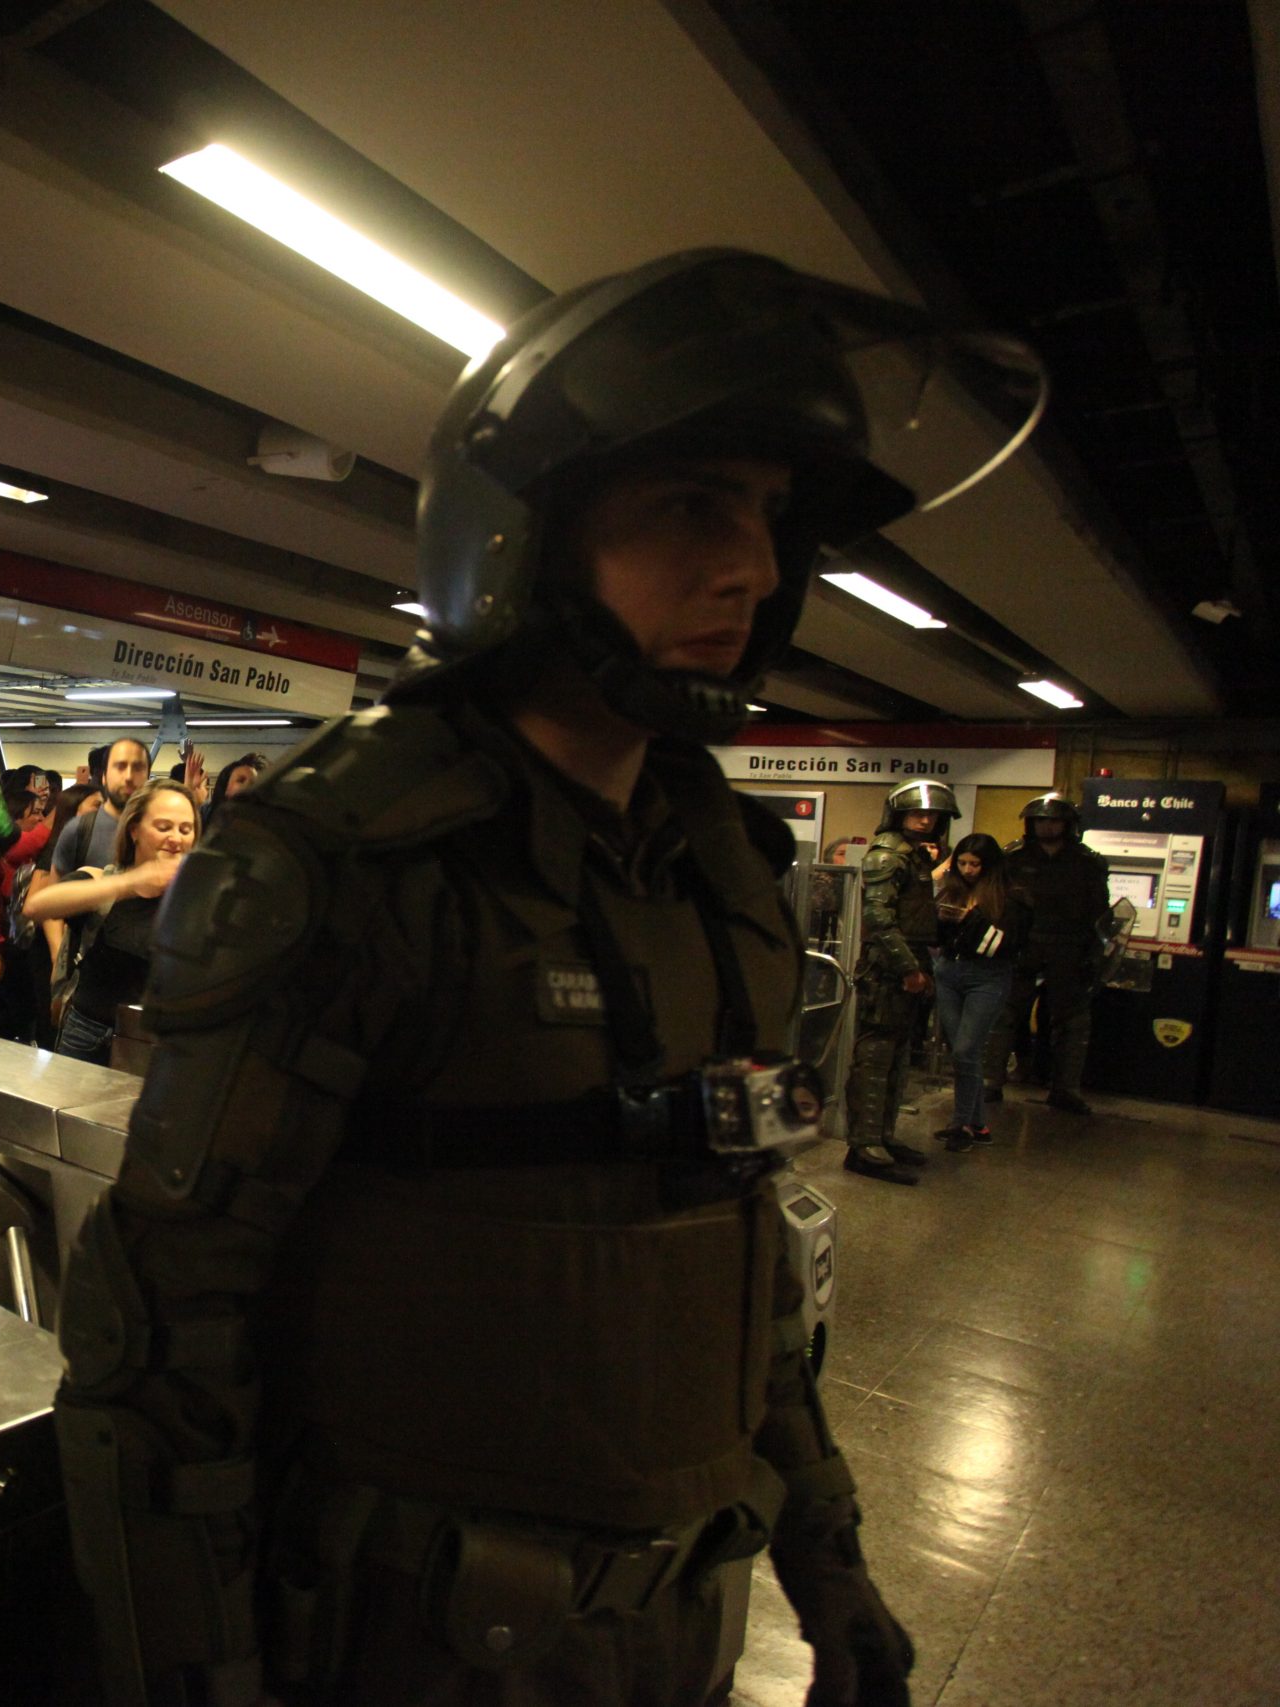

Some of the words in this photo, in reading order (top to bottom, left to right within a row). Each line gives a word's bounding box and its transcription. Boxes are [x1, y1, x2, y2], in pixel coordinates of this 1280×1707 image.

[164, 594, 236, 628] Ascensor
[114, 639, 204, 678] Dirección
[210, 659, 240, 685] San
[245, 667, 290, 694] Pablo
[750, 756, 838, 772] Dirección
[846, 758, 881, 773] San
[890, 759, 949, 774] Pablo
[800, 804, 806, 812] 1
[1097, 794, 1138, 808] Banco
[1142, 797, 1156, 808] de
[1160, 796, 1194, 809] Chile
